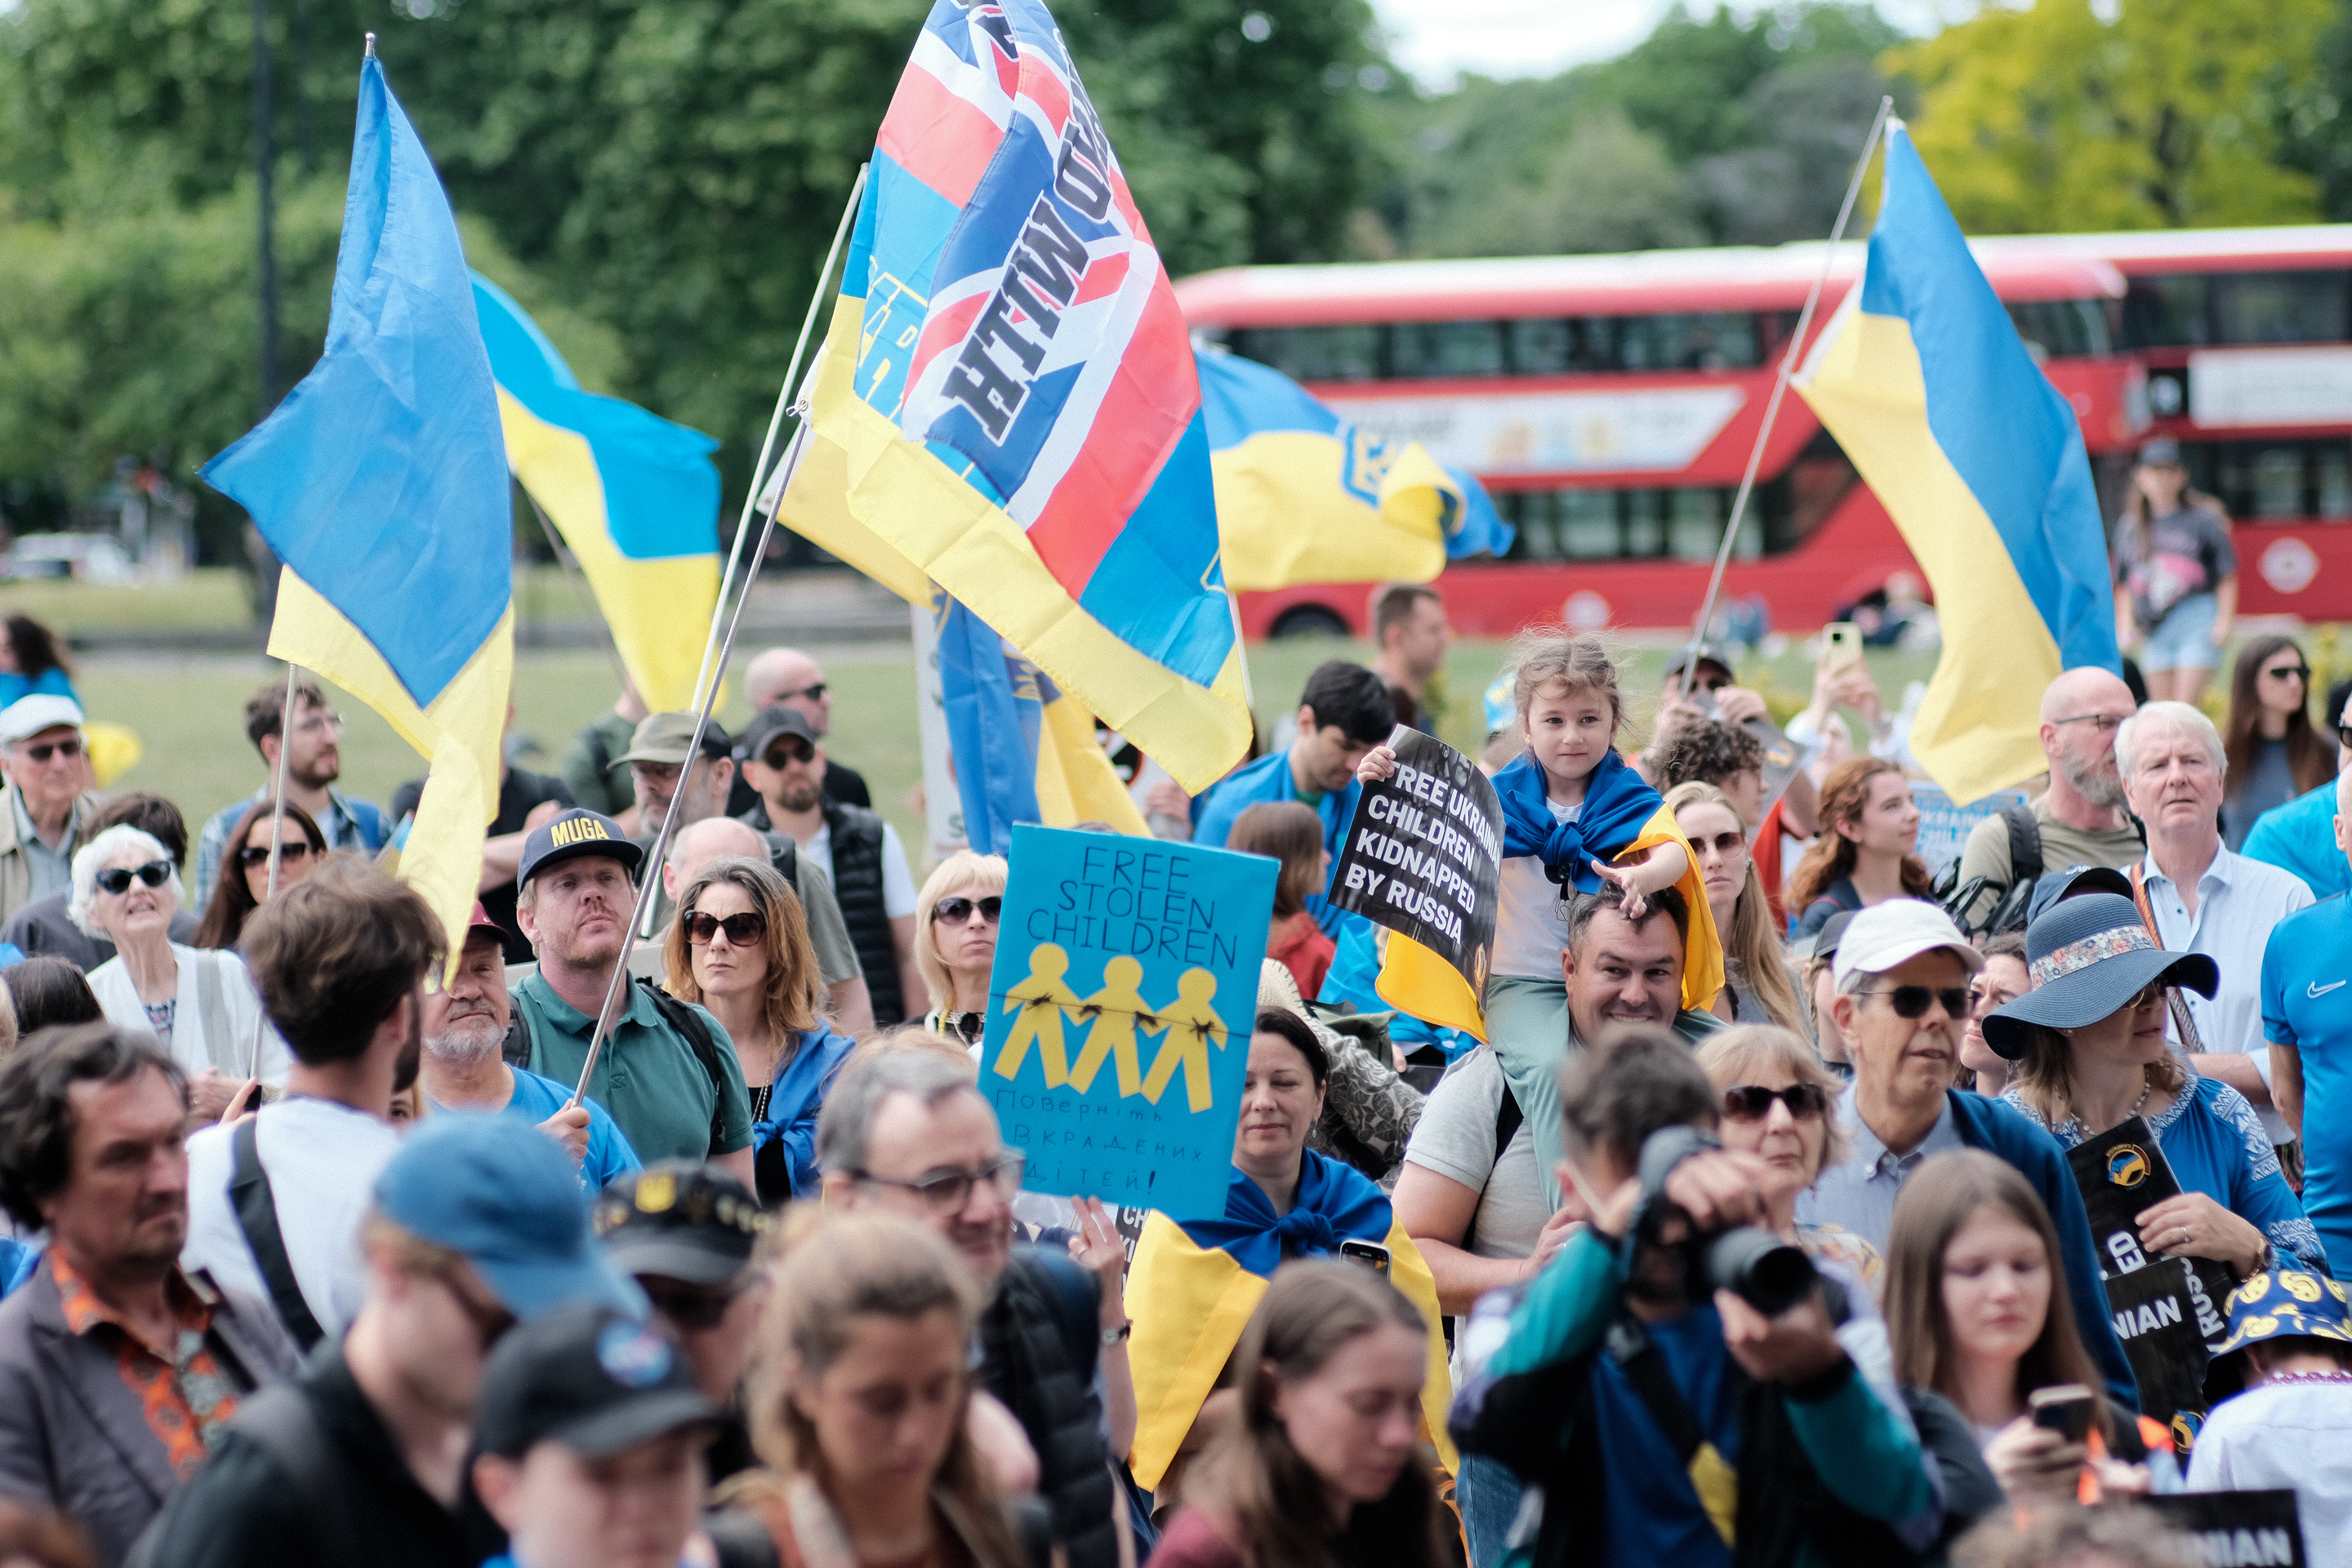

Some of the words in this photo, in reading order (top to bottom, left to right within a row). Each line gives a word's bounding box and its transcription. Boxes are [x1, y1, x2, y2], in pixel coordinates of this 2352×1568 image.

[550, 817, 610, 848] MUGA
[1369, 795, 1476, 872] CHILDREN
[1379, 759, 1449, 808] REE
[1450, 788, 1501, 876] UKRAINIAN
[1058, 880, 1214, 929] STOLEN
[1082, 846, 1191, 894] FREE
[1356, 828, 1476, 915] KIDNAPPED
[1027, 909, 1237, 970] CHILDREN
[1344, 864, 1386, 897] BY
[1386, 880, 1463, 946] RUSSIA
